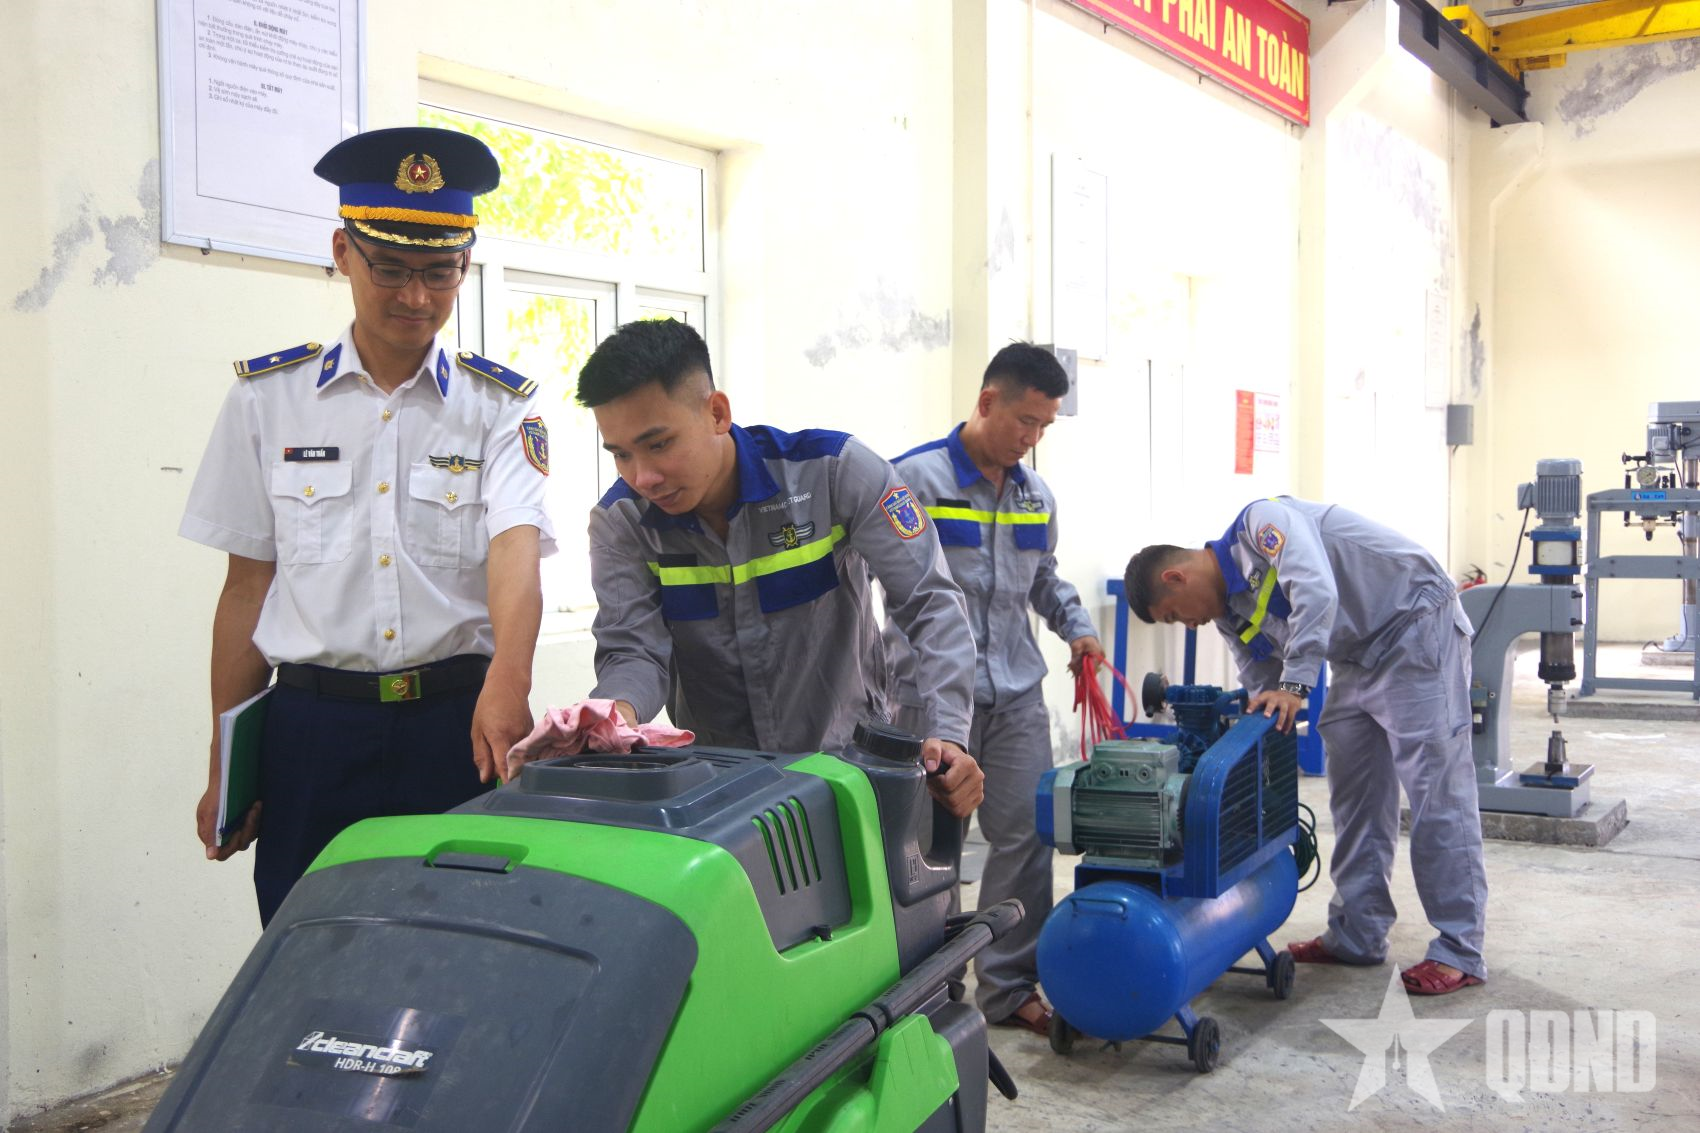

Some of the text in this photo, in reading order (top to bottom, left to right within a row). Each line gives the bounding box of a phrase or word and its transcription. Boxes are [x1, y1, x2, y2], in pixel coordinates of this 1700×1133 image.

[1222, 6, 1251, 71] AN
[1256, 25, 1304, 101] TOÀN
[334, 1057, 377, 1072] HDR-H
